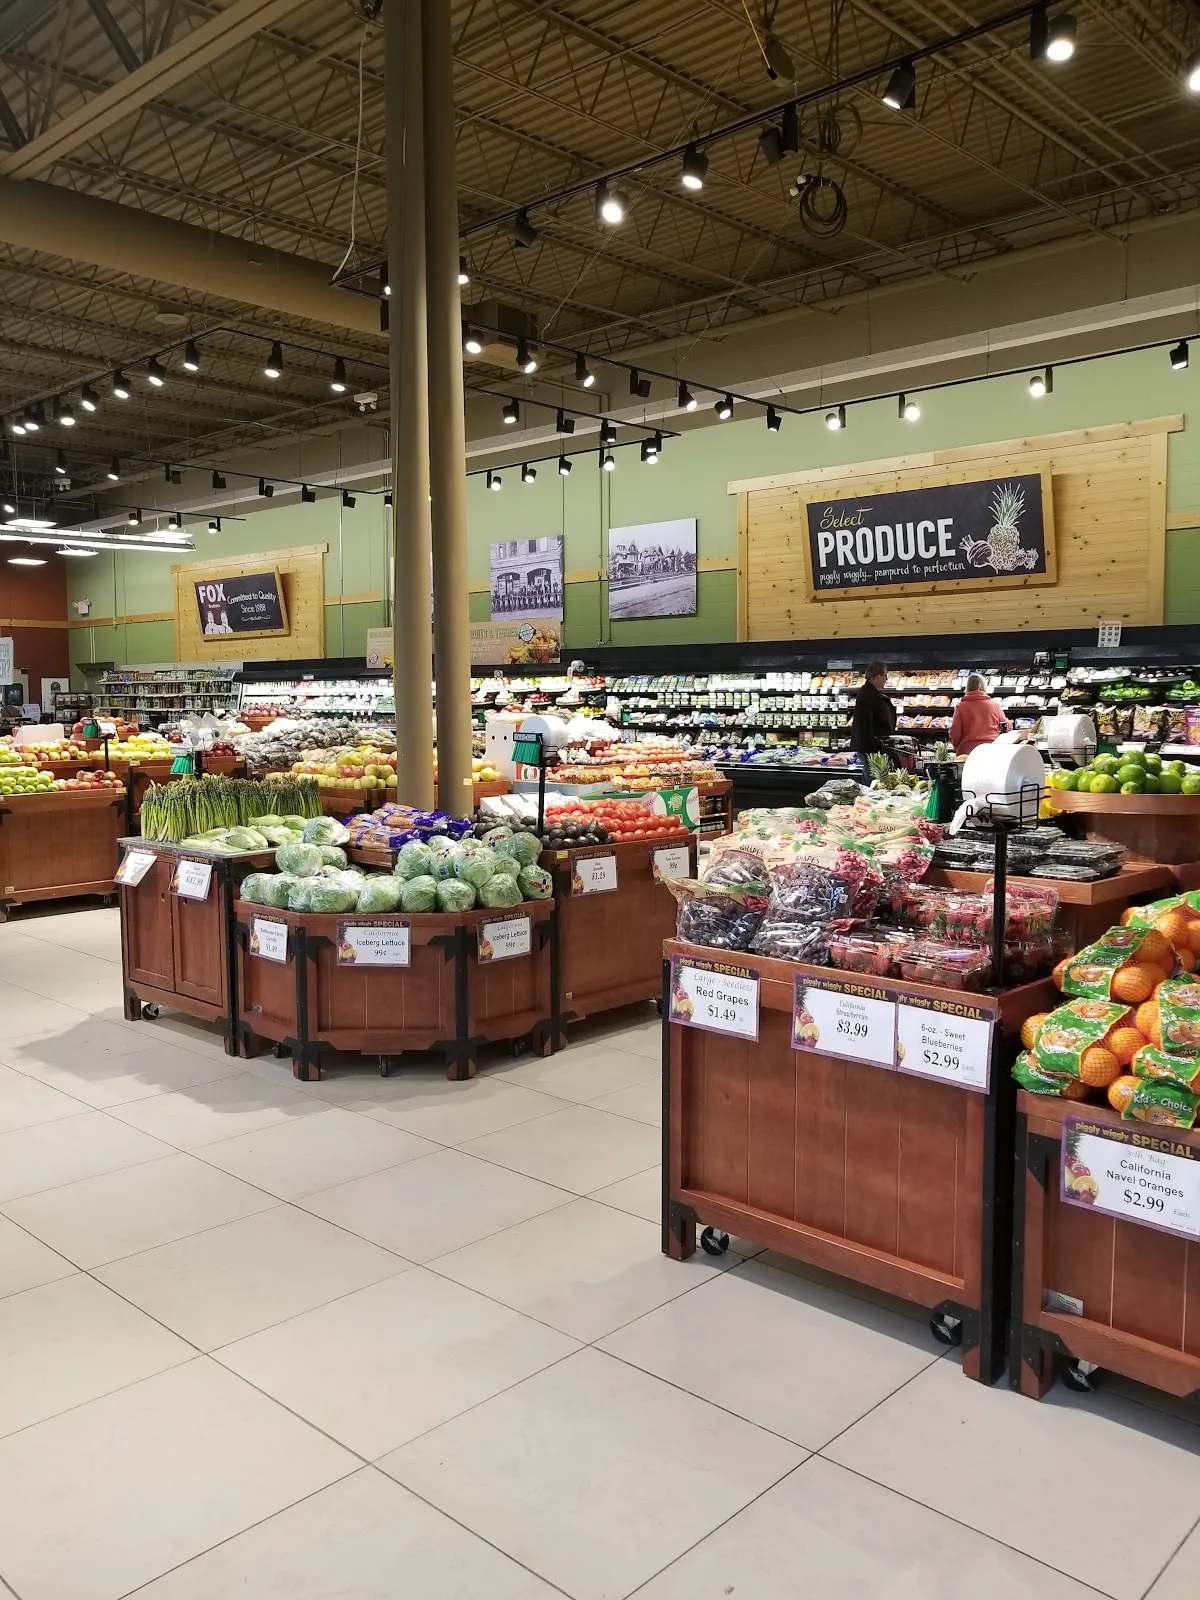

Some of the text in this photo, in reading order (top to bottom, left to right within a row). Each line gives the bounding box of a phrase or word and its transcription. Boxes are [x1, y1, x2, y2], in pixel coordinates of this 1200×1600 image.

[820, 506, 873, 530] Select
[817, 518, 957, 568] PRODUCE
[820, 570, 841, 585] piggly
[874, 565, 910, 581] pampered
[912, 564, 922, 574] to
[924, 560, 966, 578] perfection
[198, 583, 226, 604] FOX
[227, 590, 276, 604] Committed to Quality
[356, 938, 380, 948] Iceberg
[694, 973, 714, 986] Large
[713, 963, 752, 978] SPECIAL
[696, 986, 749, 1006] Red Grapes
[802, 978, 888, 1001] piggly wiggly SPECIAL
[708, 1004, 736, 1022] $1.49
[836, 1008, 869, 1020] Strawberries
[840, 999, 866, 1011] California
[909, 996, 932, 1008] wiggly
[932, 1000, 983, 1019] SPECIAL
[836, 1020, 868, 1038] $3.99
[921, 1023, 936, 1034] 6-oz.
[944, 1028, 966, 1041] Sweet
[922, 1036, 963, 1053] Blueberries
[923, 1048, 960, 1070] $2.99
[1133, 1092, 1193, 1112] Kid's Choice
[1075, 1122, 1195, 1159] piggly wiggly SPECIAL
[1120, 1159, 1172, 1181] California
[1106, 1169, 1184, 1198] Navel Oranges
[1123, 1188, 1164, 1213] $2.99
